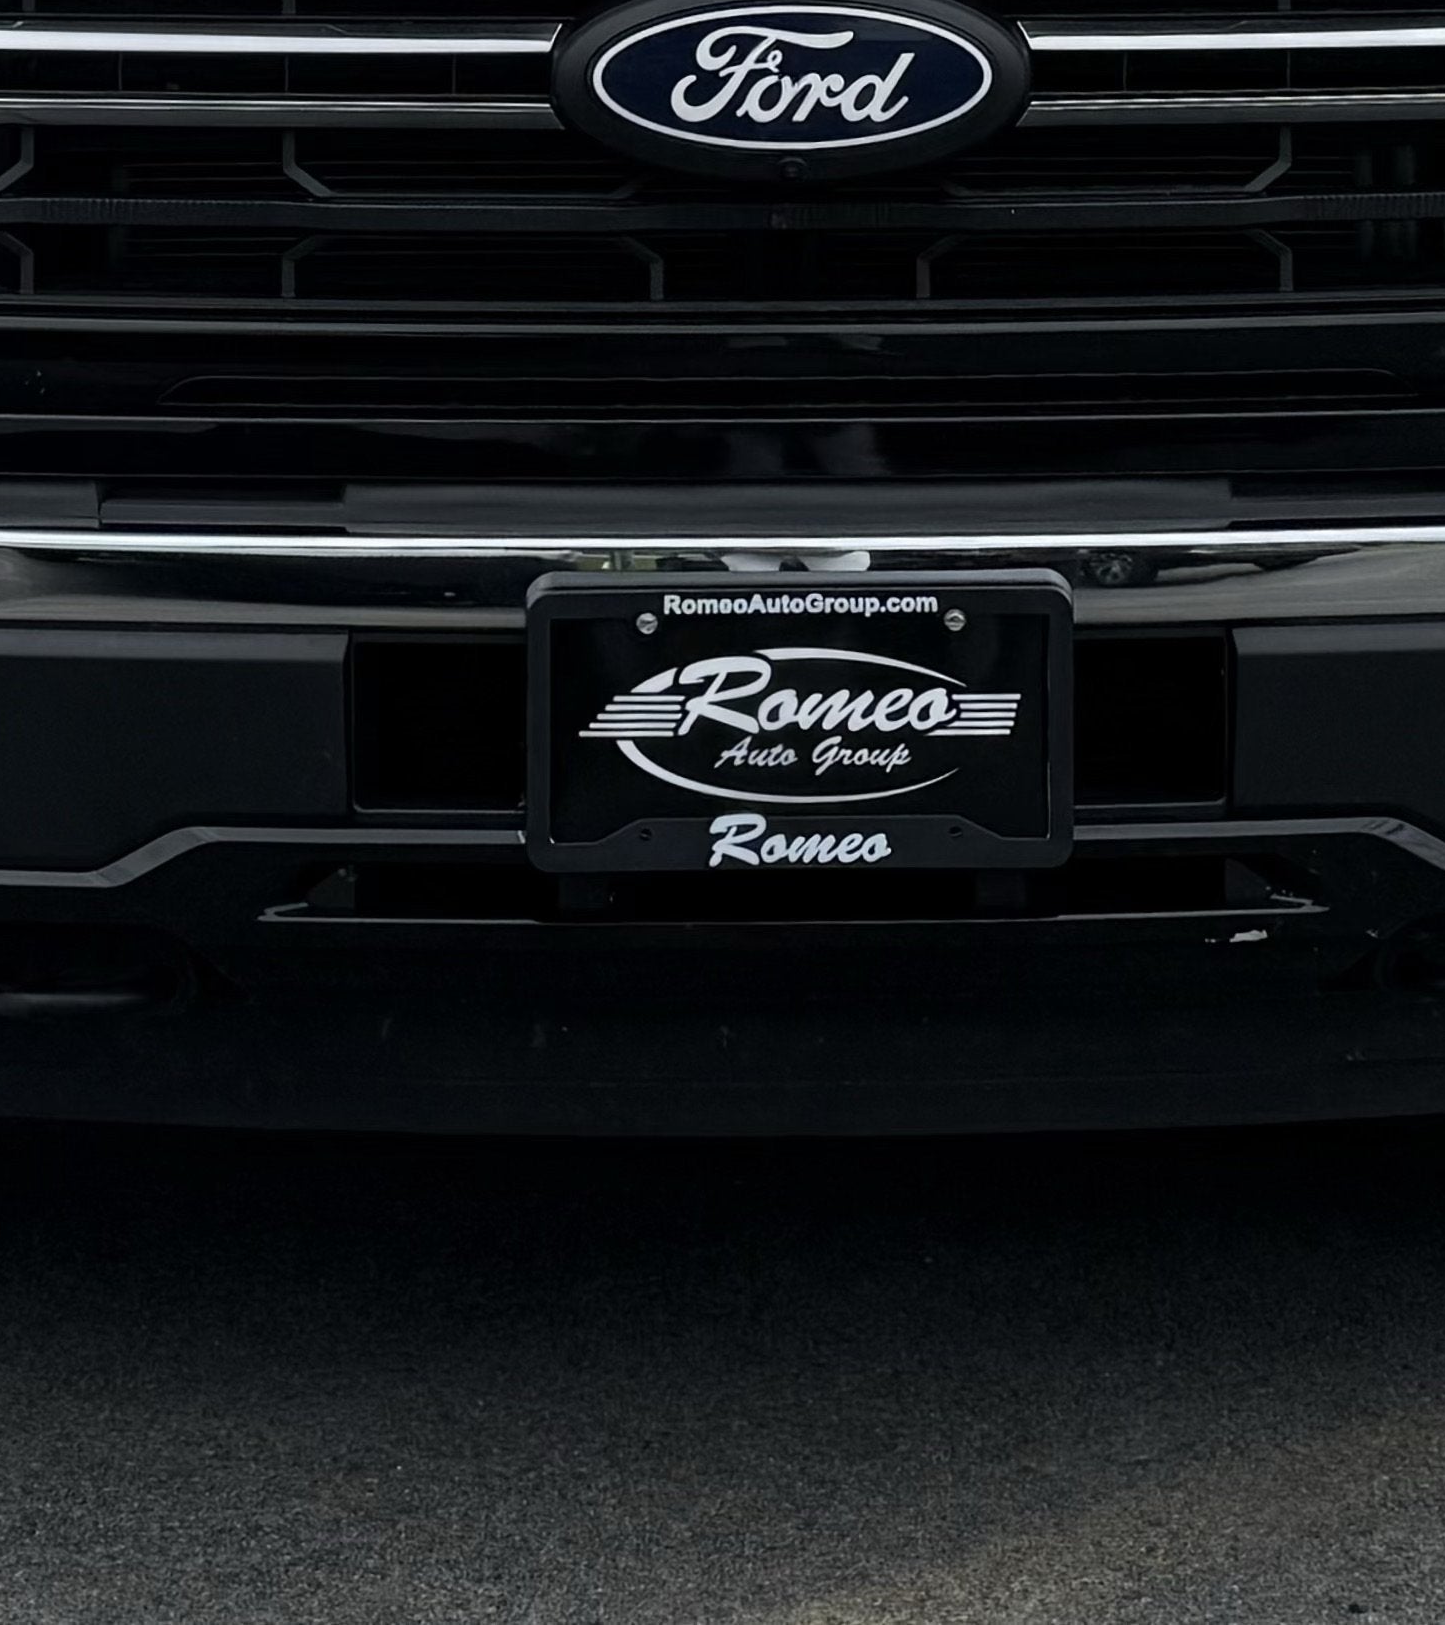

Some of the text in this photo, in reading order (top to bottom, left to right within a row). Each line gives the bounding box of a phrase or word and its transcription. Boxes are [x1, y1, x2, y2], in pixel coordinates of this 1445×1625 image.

[670, 25, 916, 123] Ford
[662, 593, 938, 616] RomeoAutoGroup.com
[677, 654, 959, 735] Romeo
[714, 735, 912, 776] Auto Group
[708, 812, 893, 868] Romeo
